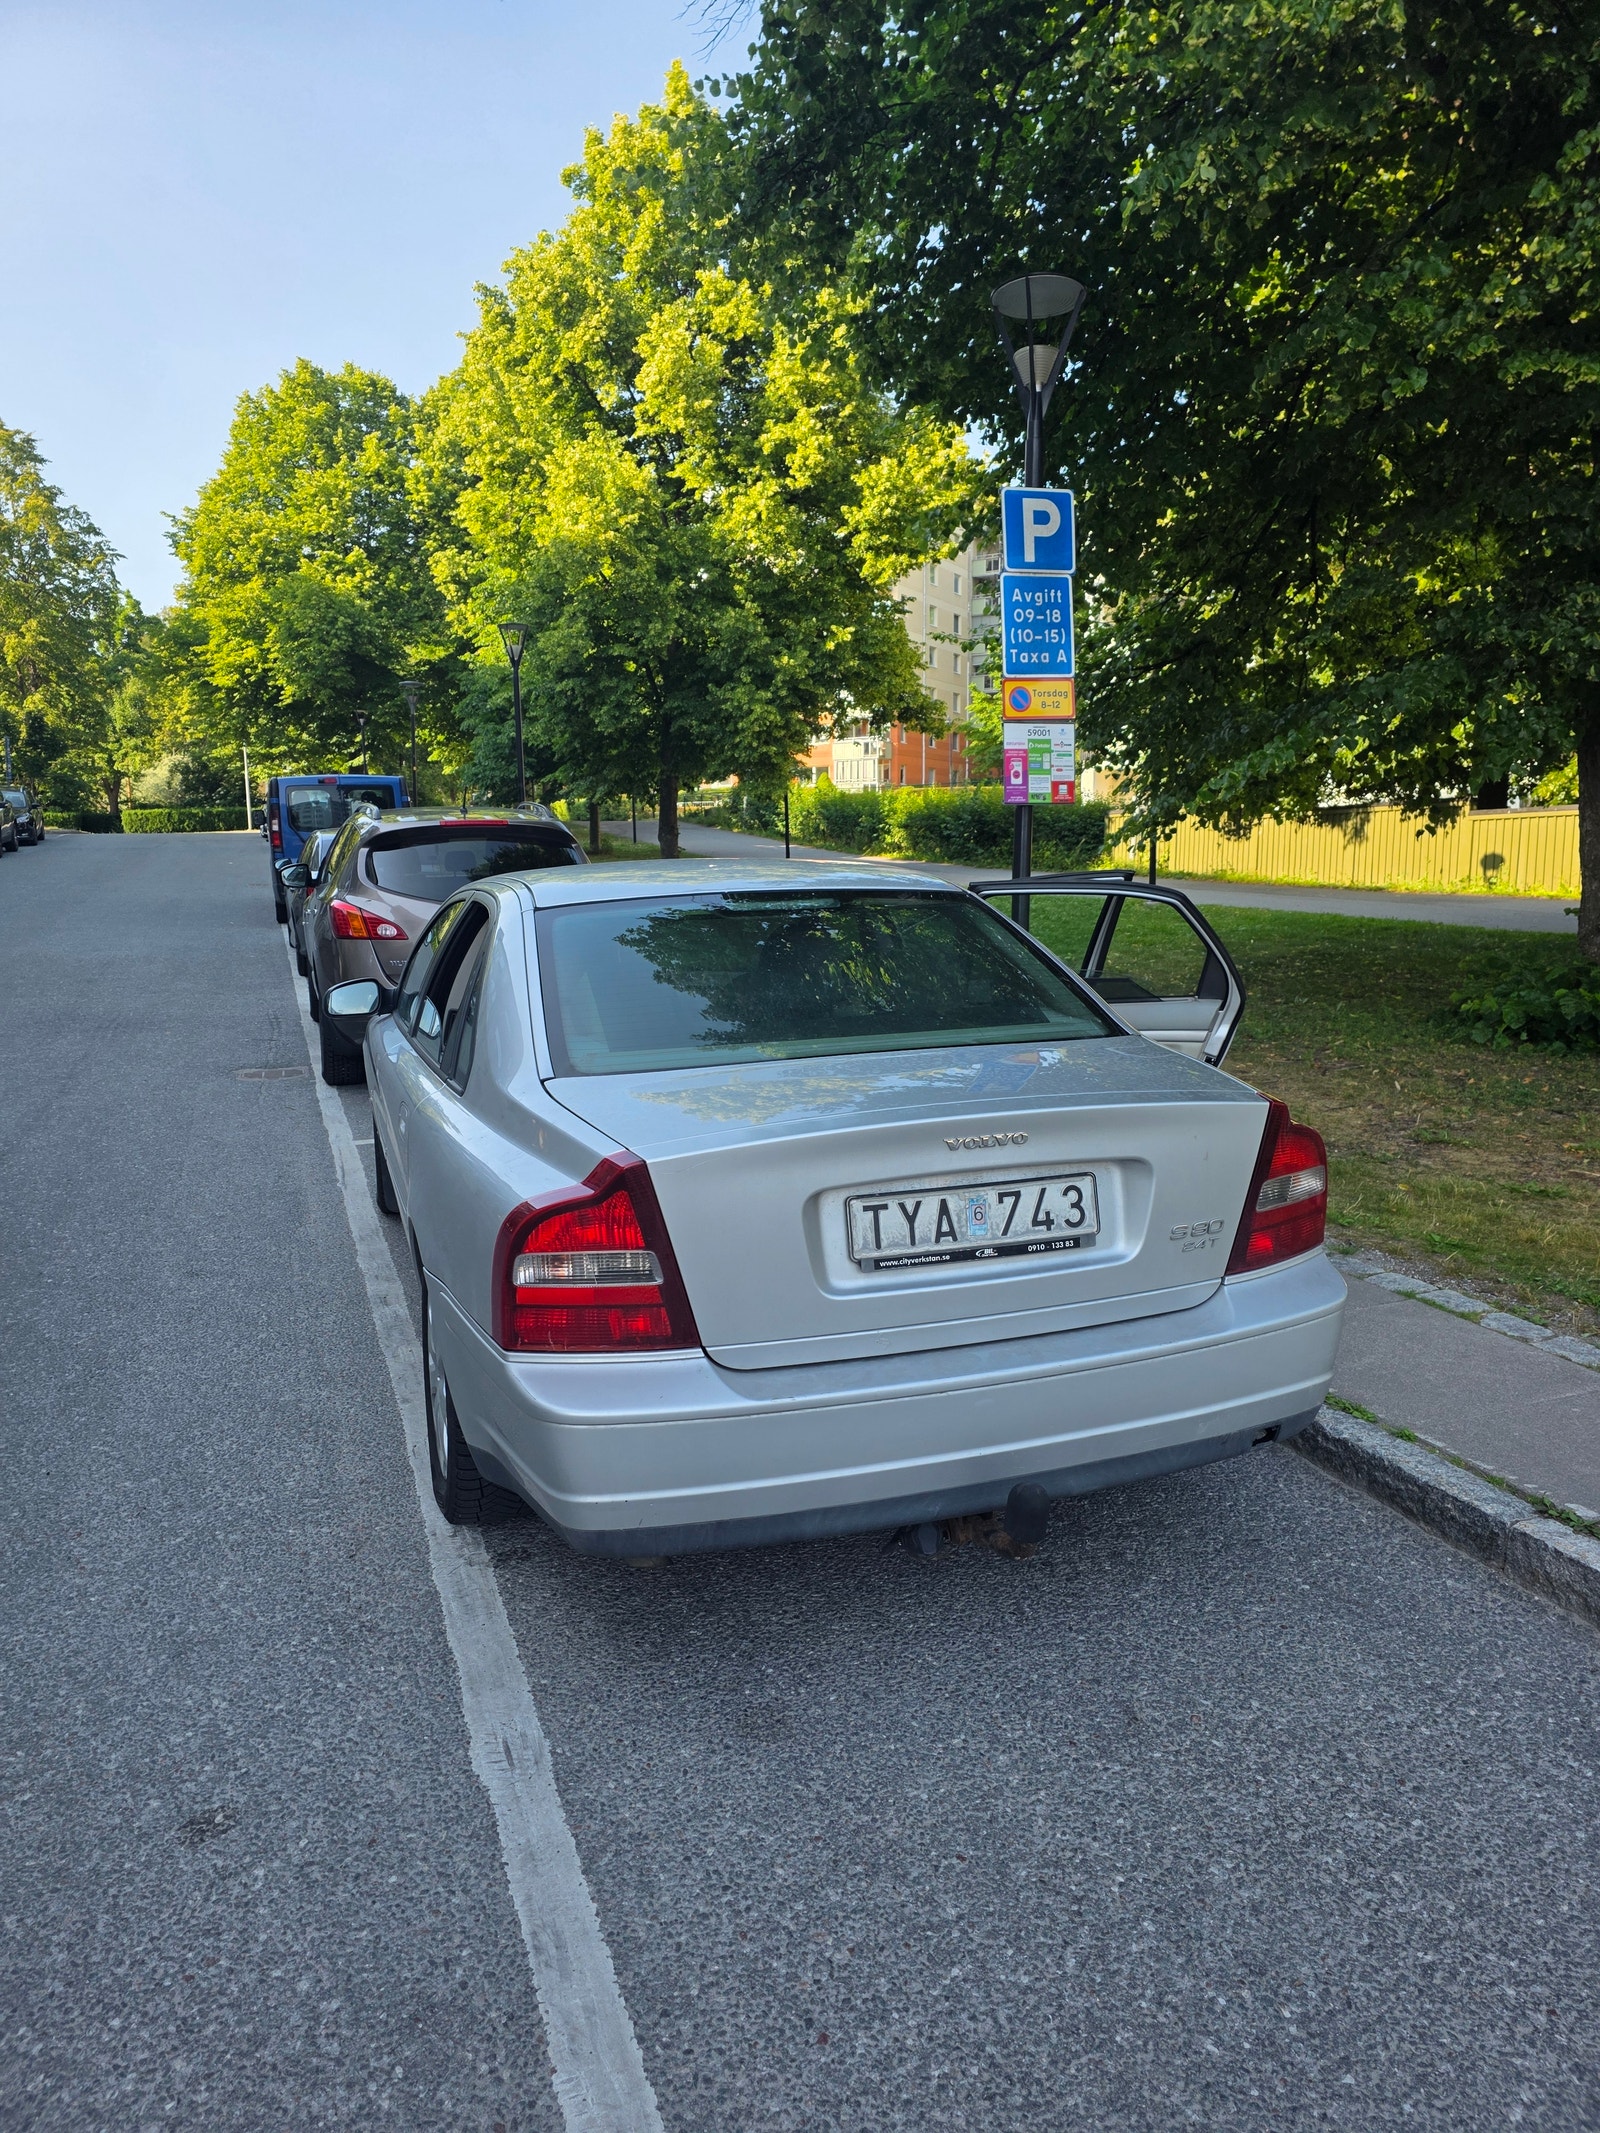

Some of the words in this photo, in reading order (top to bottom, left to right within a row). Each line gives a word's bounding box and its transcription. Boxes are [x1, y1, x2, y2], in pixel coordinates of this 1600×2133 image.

[1022, 498, 1061, 563] P
[1012, 588, 1062, 605] Avgift
[1014, 609, 1062, 623] 09-18
[1010, 628, 1066, 644] (10-15)
[1010, 649, 1049, 663] Taxa
[1056, 648, 1067, 663] A
[1032, 689, 1069, 698] Torsdag
[1041, 701, 1061, 709] 8-12
[1027, 729, 1051, 737] 59001
[943, 1132, 1029, 1151] VOLVO
[862, 1198, 958, 1250] TYA
[997, 1184, 1087, 1237] 743
[972, 1205, 984, 1223] 6
[1169, 1218, 1225, 1241] S80
[1051, 1241, 1064, 1249] 133
[879, 1254, 951, 1268] www.cityverkstan.se
